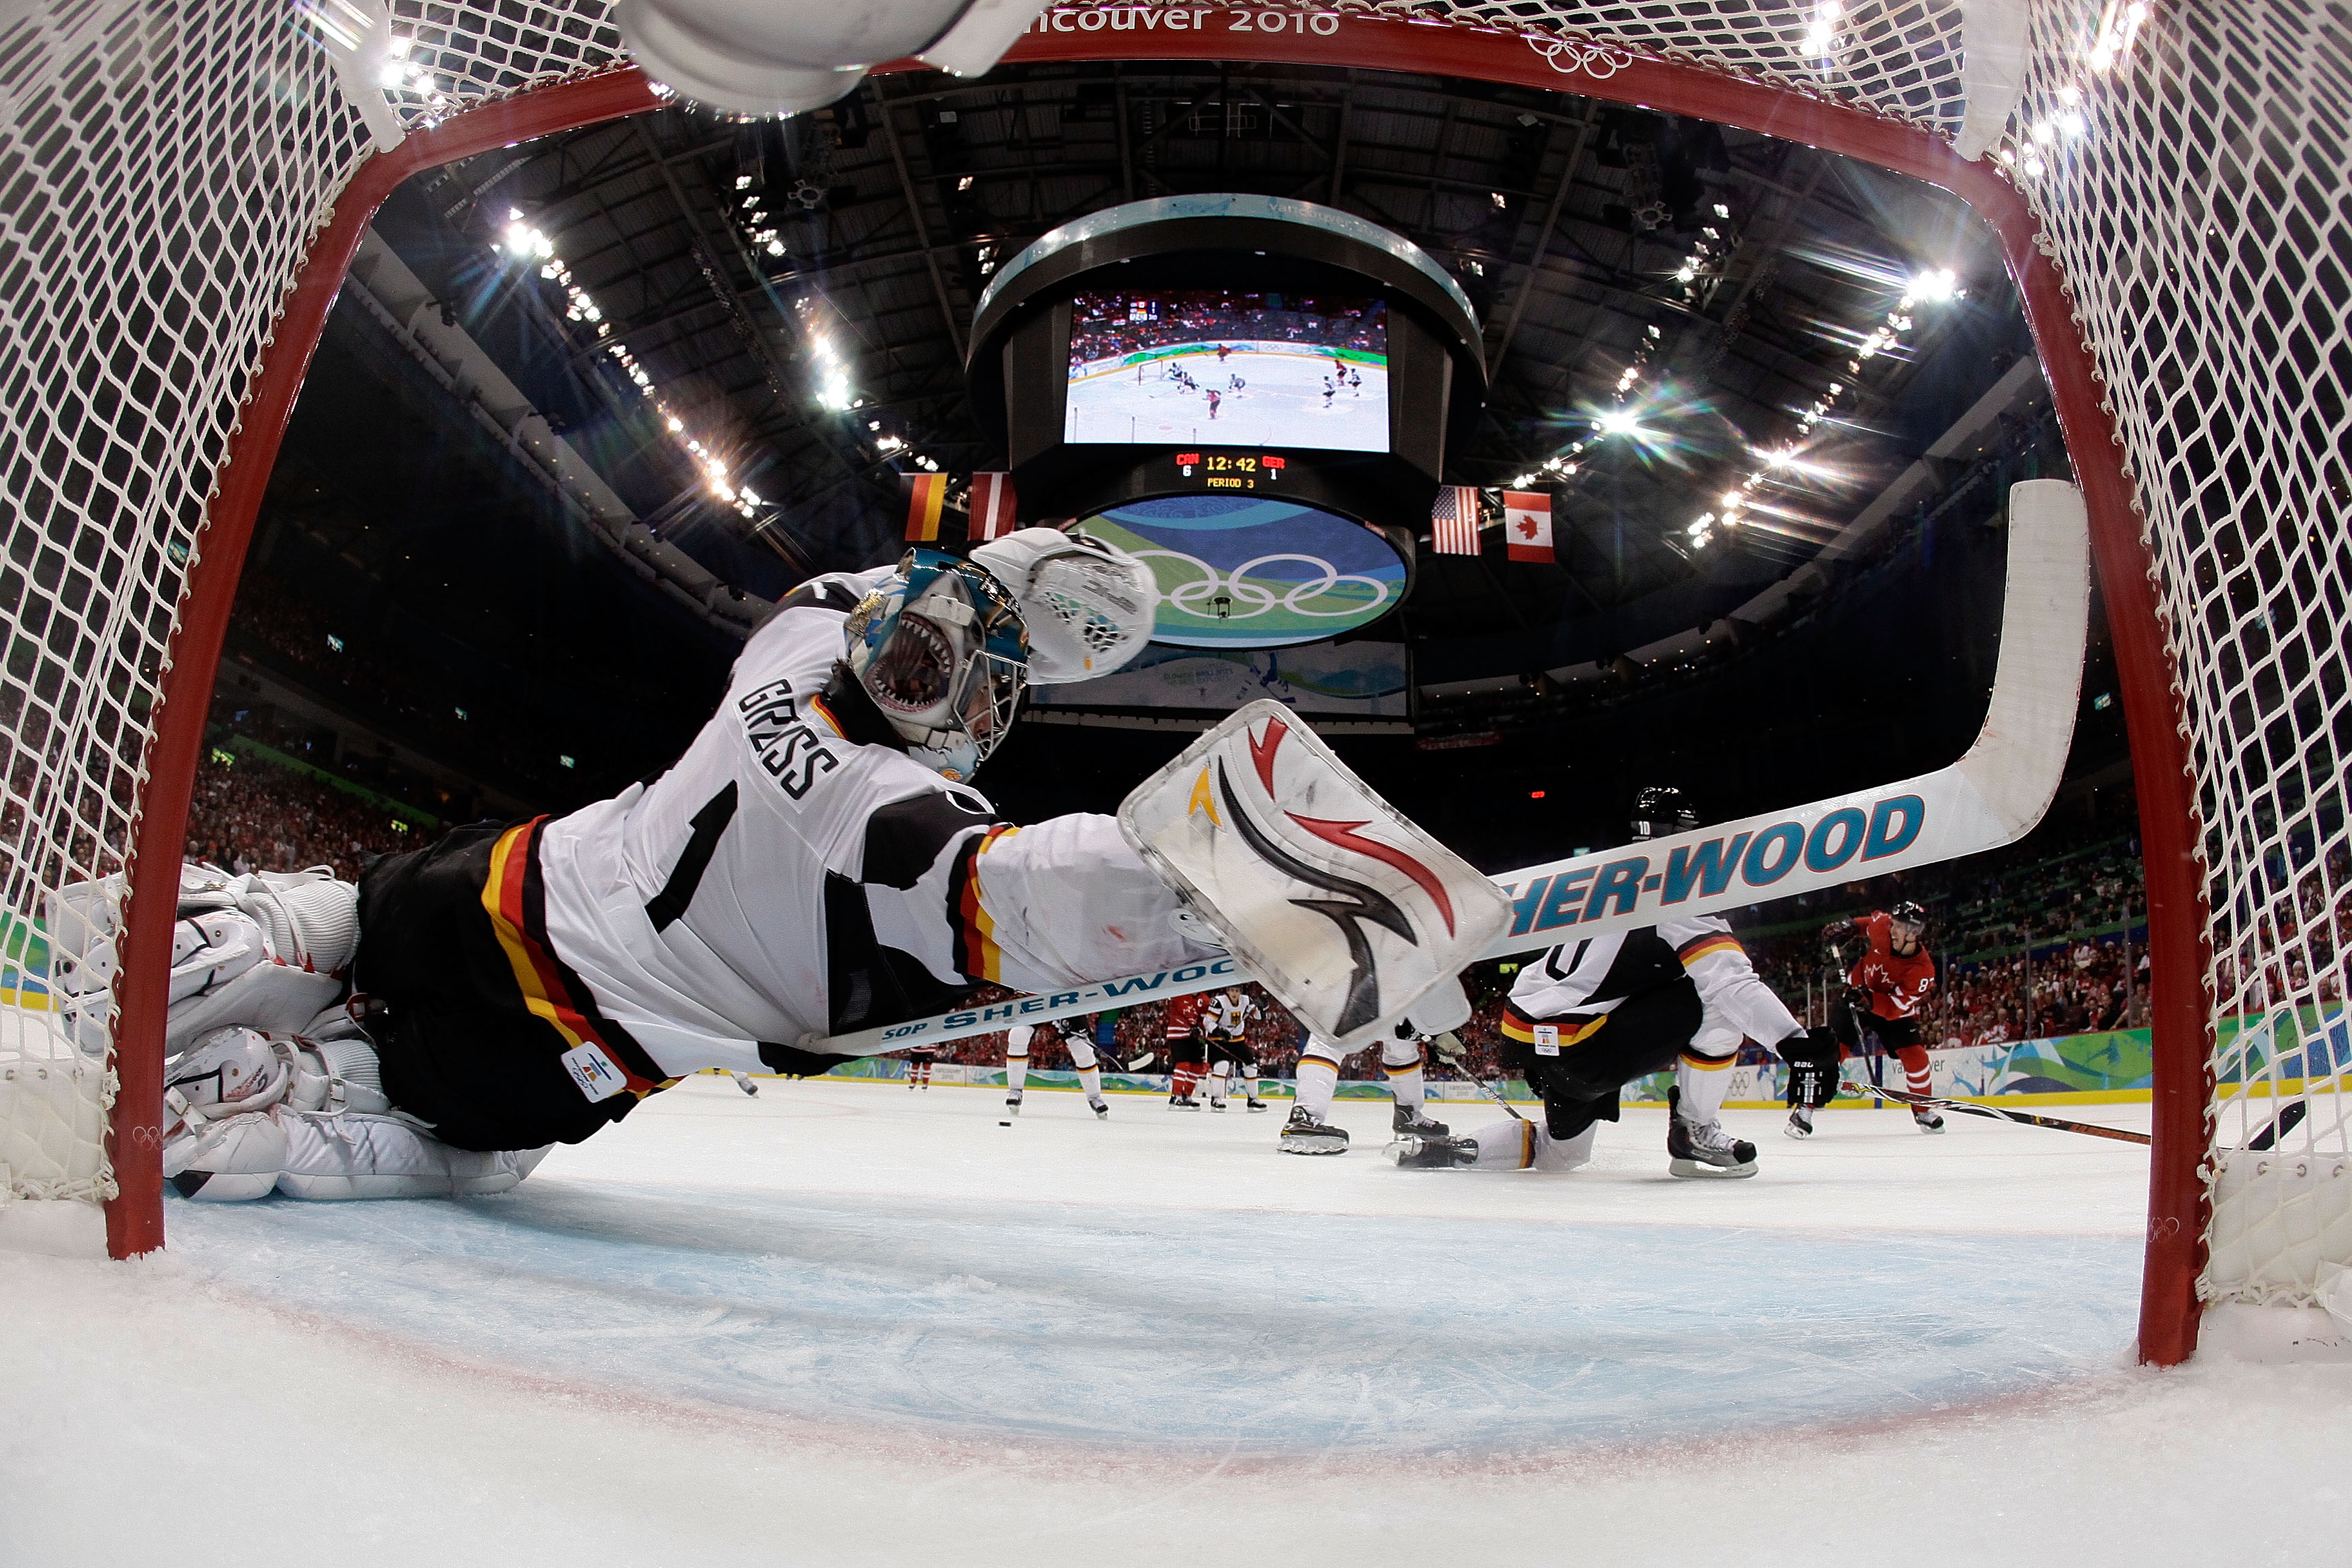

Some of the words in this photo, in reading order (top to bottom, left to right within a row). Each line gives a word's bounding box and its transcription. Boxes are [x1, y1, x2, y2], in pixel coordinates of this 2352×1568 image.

[1228, 10, 1340, 35] 2010
[1176, 453, 1200, 466] CAN
[1207, 456, 1256, 472] 12:42
[1262, 455, 1286, 469] GER
[1182, 464, 1192, 477] 6
[1270, 468, 1277, 480] 1
[1207, 477, 1242, 488] PERIOD
[1247, 479, 1254, 489] 3
[1638, 820, 1651, 835] 10
[644, 778, 738, 935] 1
[1197, 998, 1203, 1008] C
[882, 1023, 928, 1040] SOP
